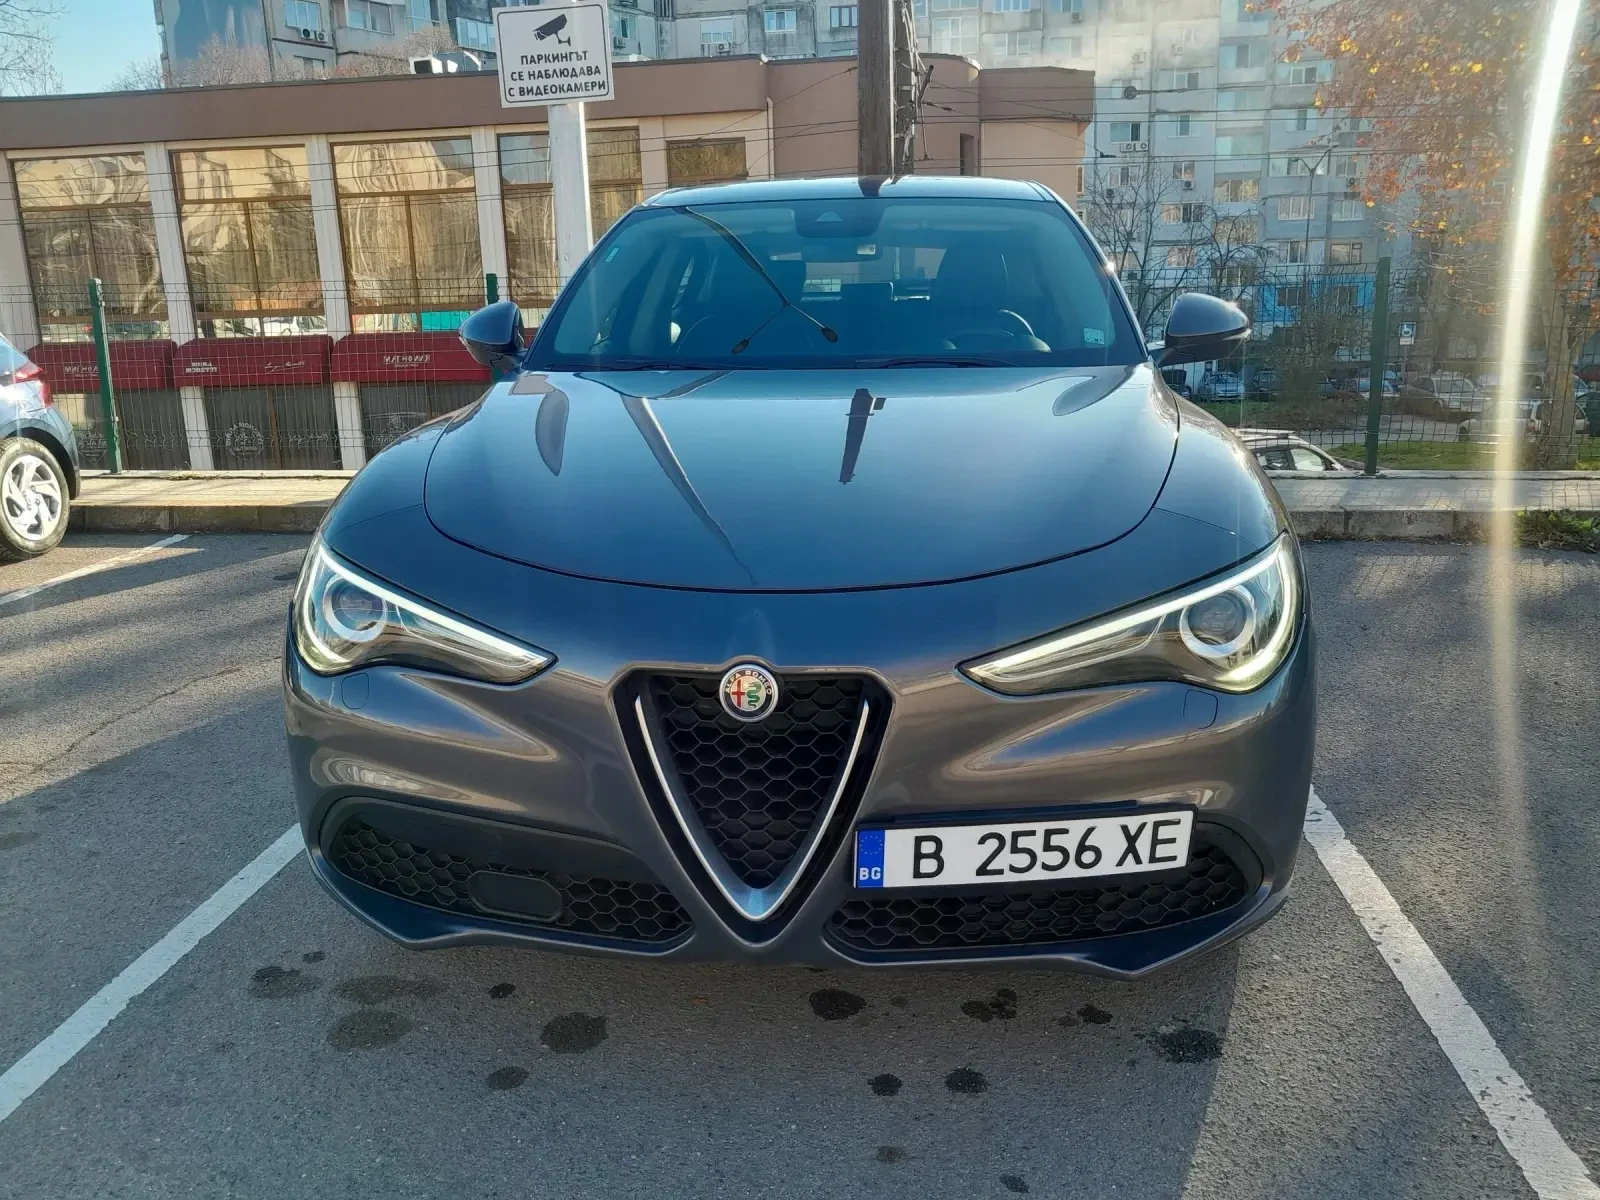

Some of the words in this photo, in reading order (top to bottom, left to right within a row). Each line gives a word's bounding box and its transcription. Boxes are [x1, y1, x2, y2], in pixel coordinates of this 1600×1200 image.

[520, 51, 588, 65] ПАРКИНГЪТ
[510, 72, 525, 82] СЕ
[528, 65, 601, 81] НАБЛЮДАВА
[508, 87, 515, 97] С
[518, 80, 606, 97] ВИДЕОКАМЕРИ
[725, 672, 742, 694] ALFA
[745, 670, 772, 695] ROMEO
[912, 834, 945, 879] B
[975, 826, 1102, 876] 2556
[1115, 818, 1181, 867] XE
[860, 867, 881, 880] BG
